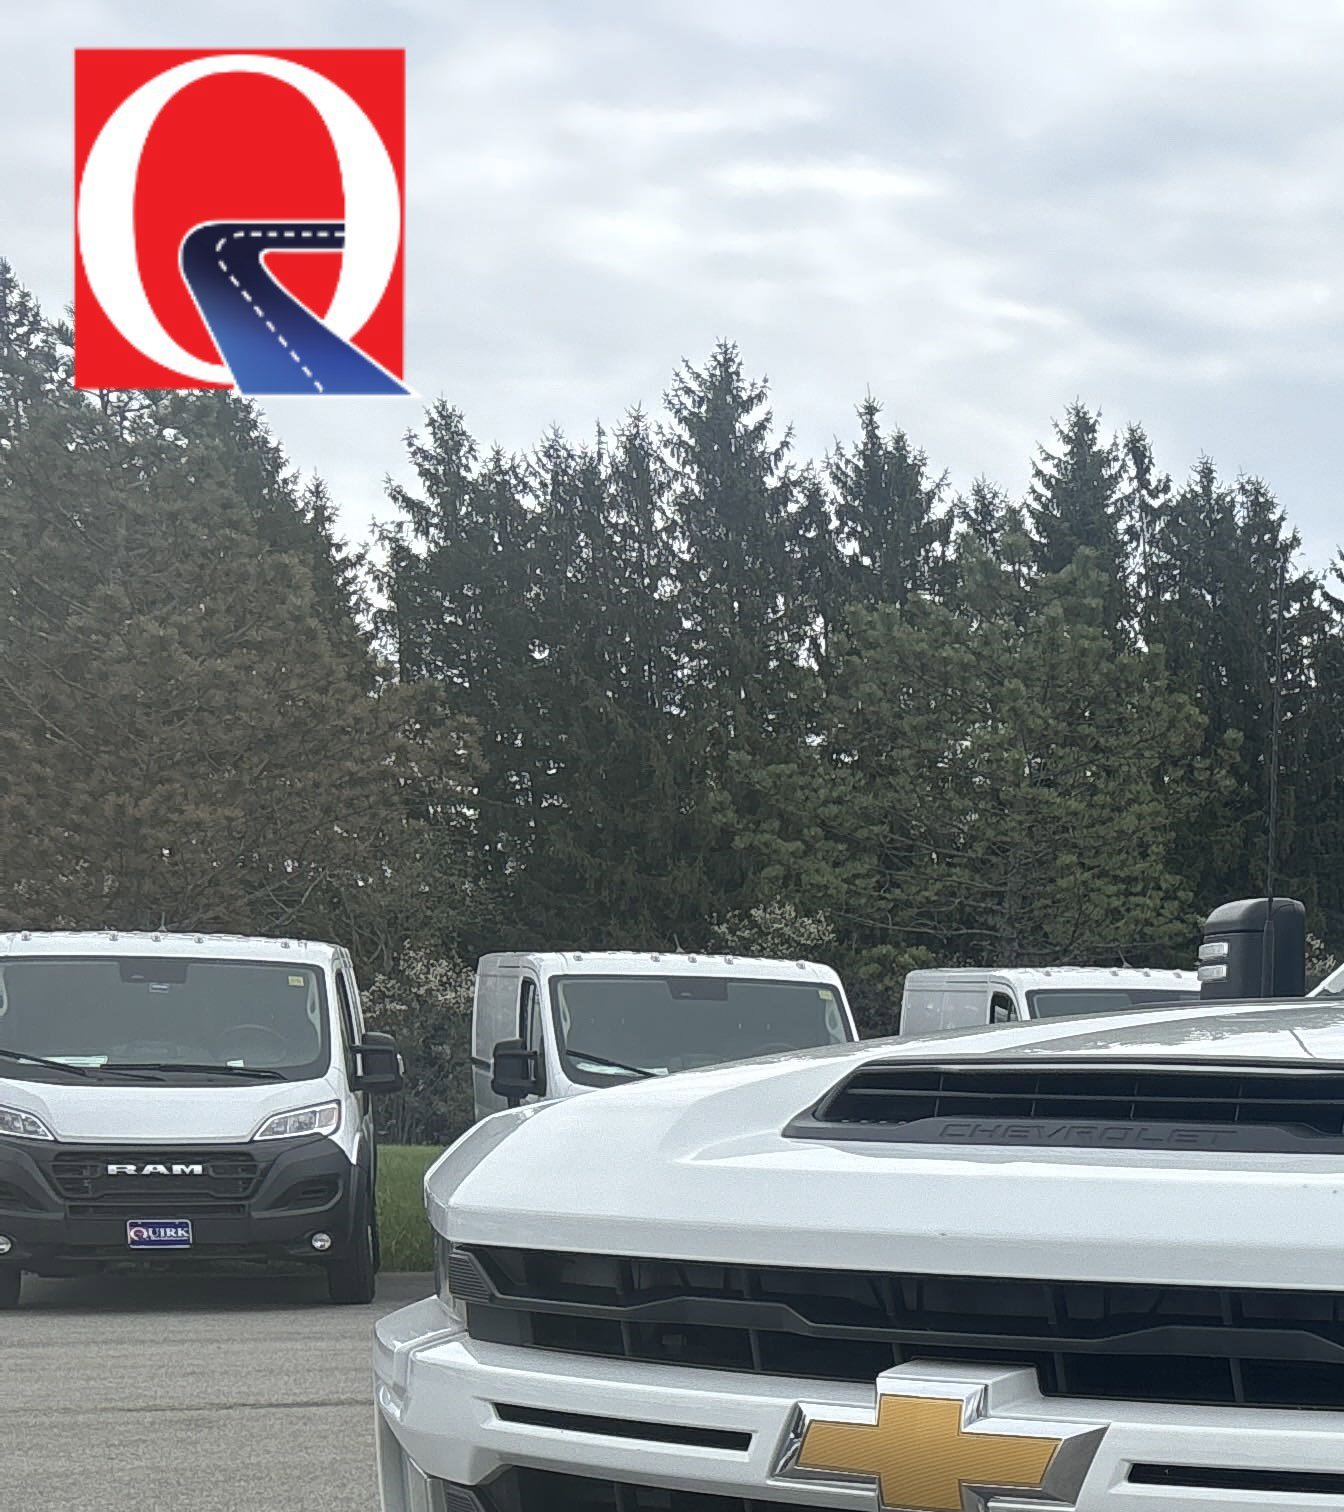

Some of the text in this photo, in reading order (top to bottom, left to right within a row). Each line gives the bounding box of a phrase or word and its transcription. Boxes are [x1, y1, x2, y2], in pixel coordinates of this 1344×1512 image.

[938, 1122, 1238, 1146] CHEVROLET
[107, 1164, 204, 1175] RAM
[130, 1227, 190, 1241] QUIRK
